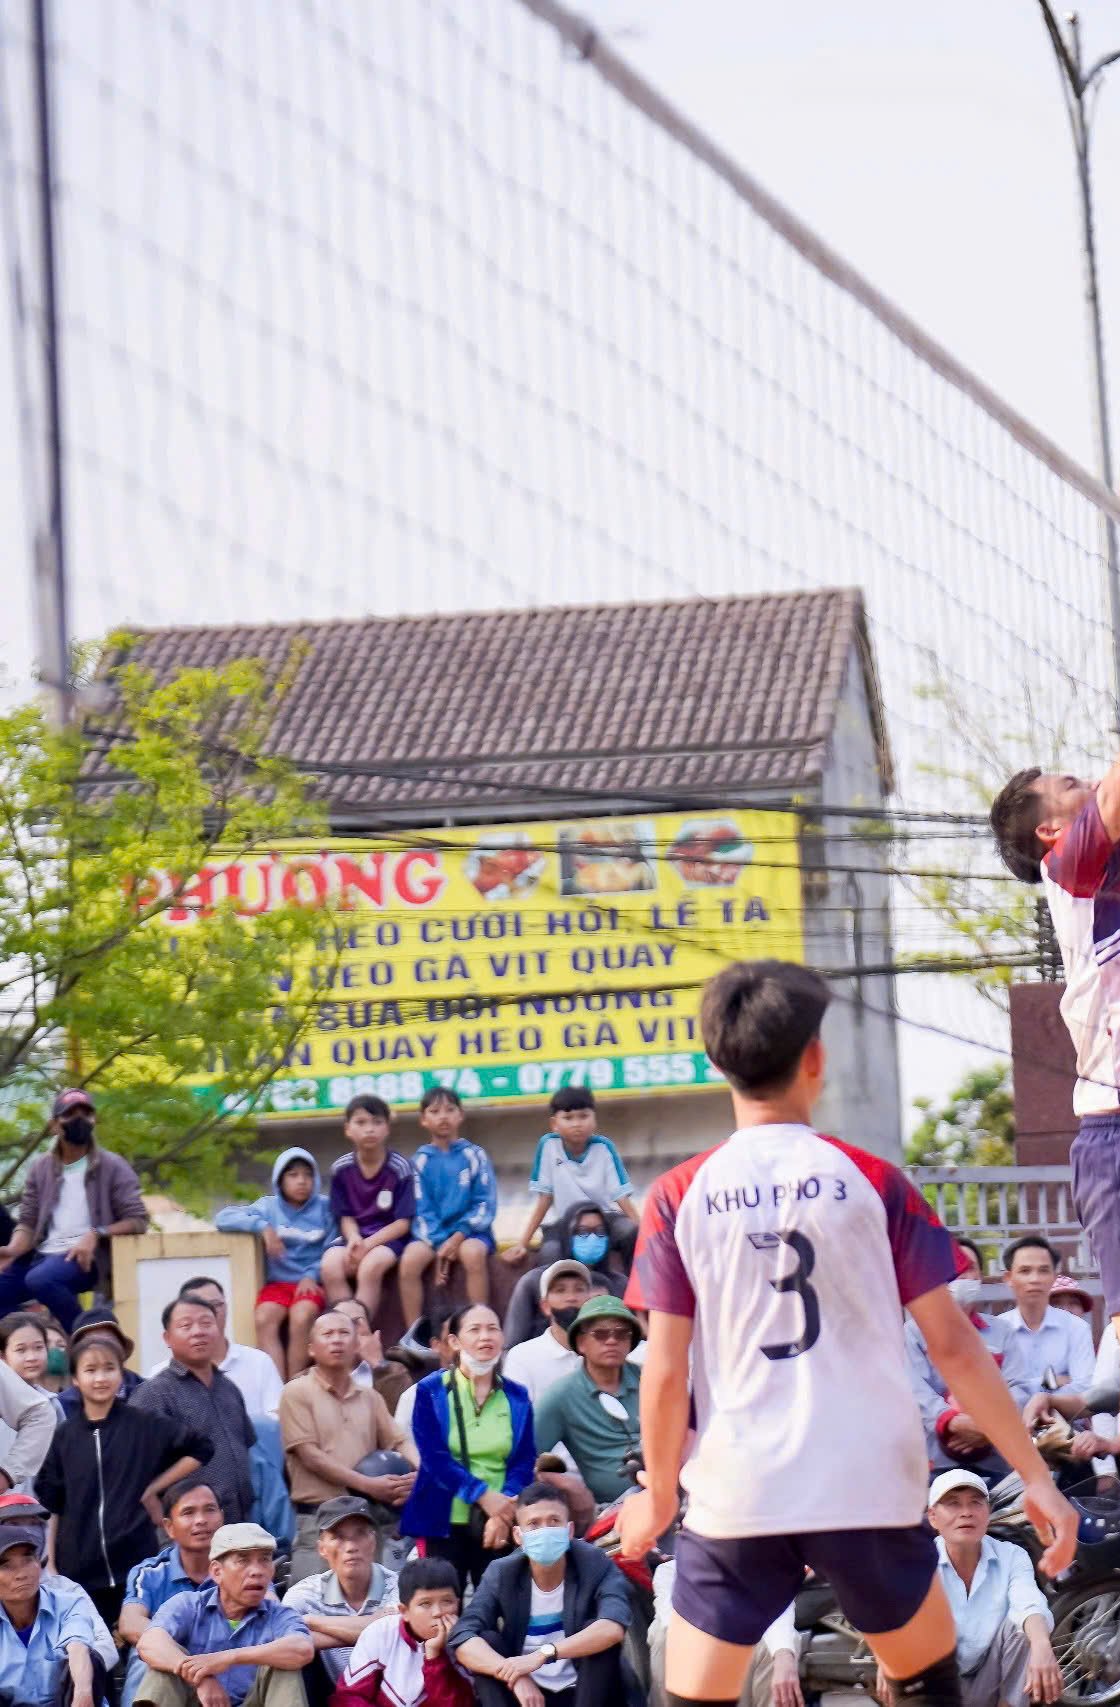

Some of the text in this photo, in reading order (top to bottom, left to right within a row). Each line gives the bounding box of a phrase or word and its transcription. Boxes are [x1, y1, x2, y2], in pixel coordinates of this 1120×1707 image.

[571, 943, 677, 977] QUAY
[333, 1032, 436, 1066] QUAY
[459, 1027, 542, 1056] HEO
[623, 1054, 697, 1087] 555
[706, 1184, 761, 1215] KHU
[832, 1178, 848, 1201] 3
[746, 1229, 821, 1361] 3
